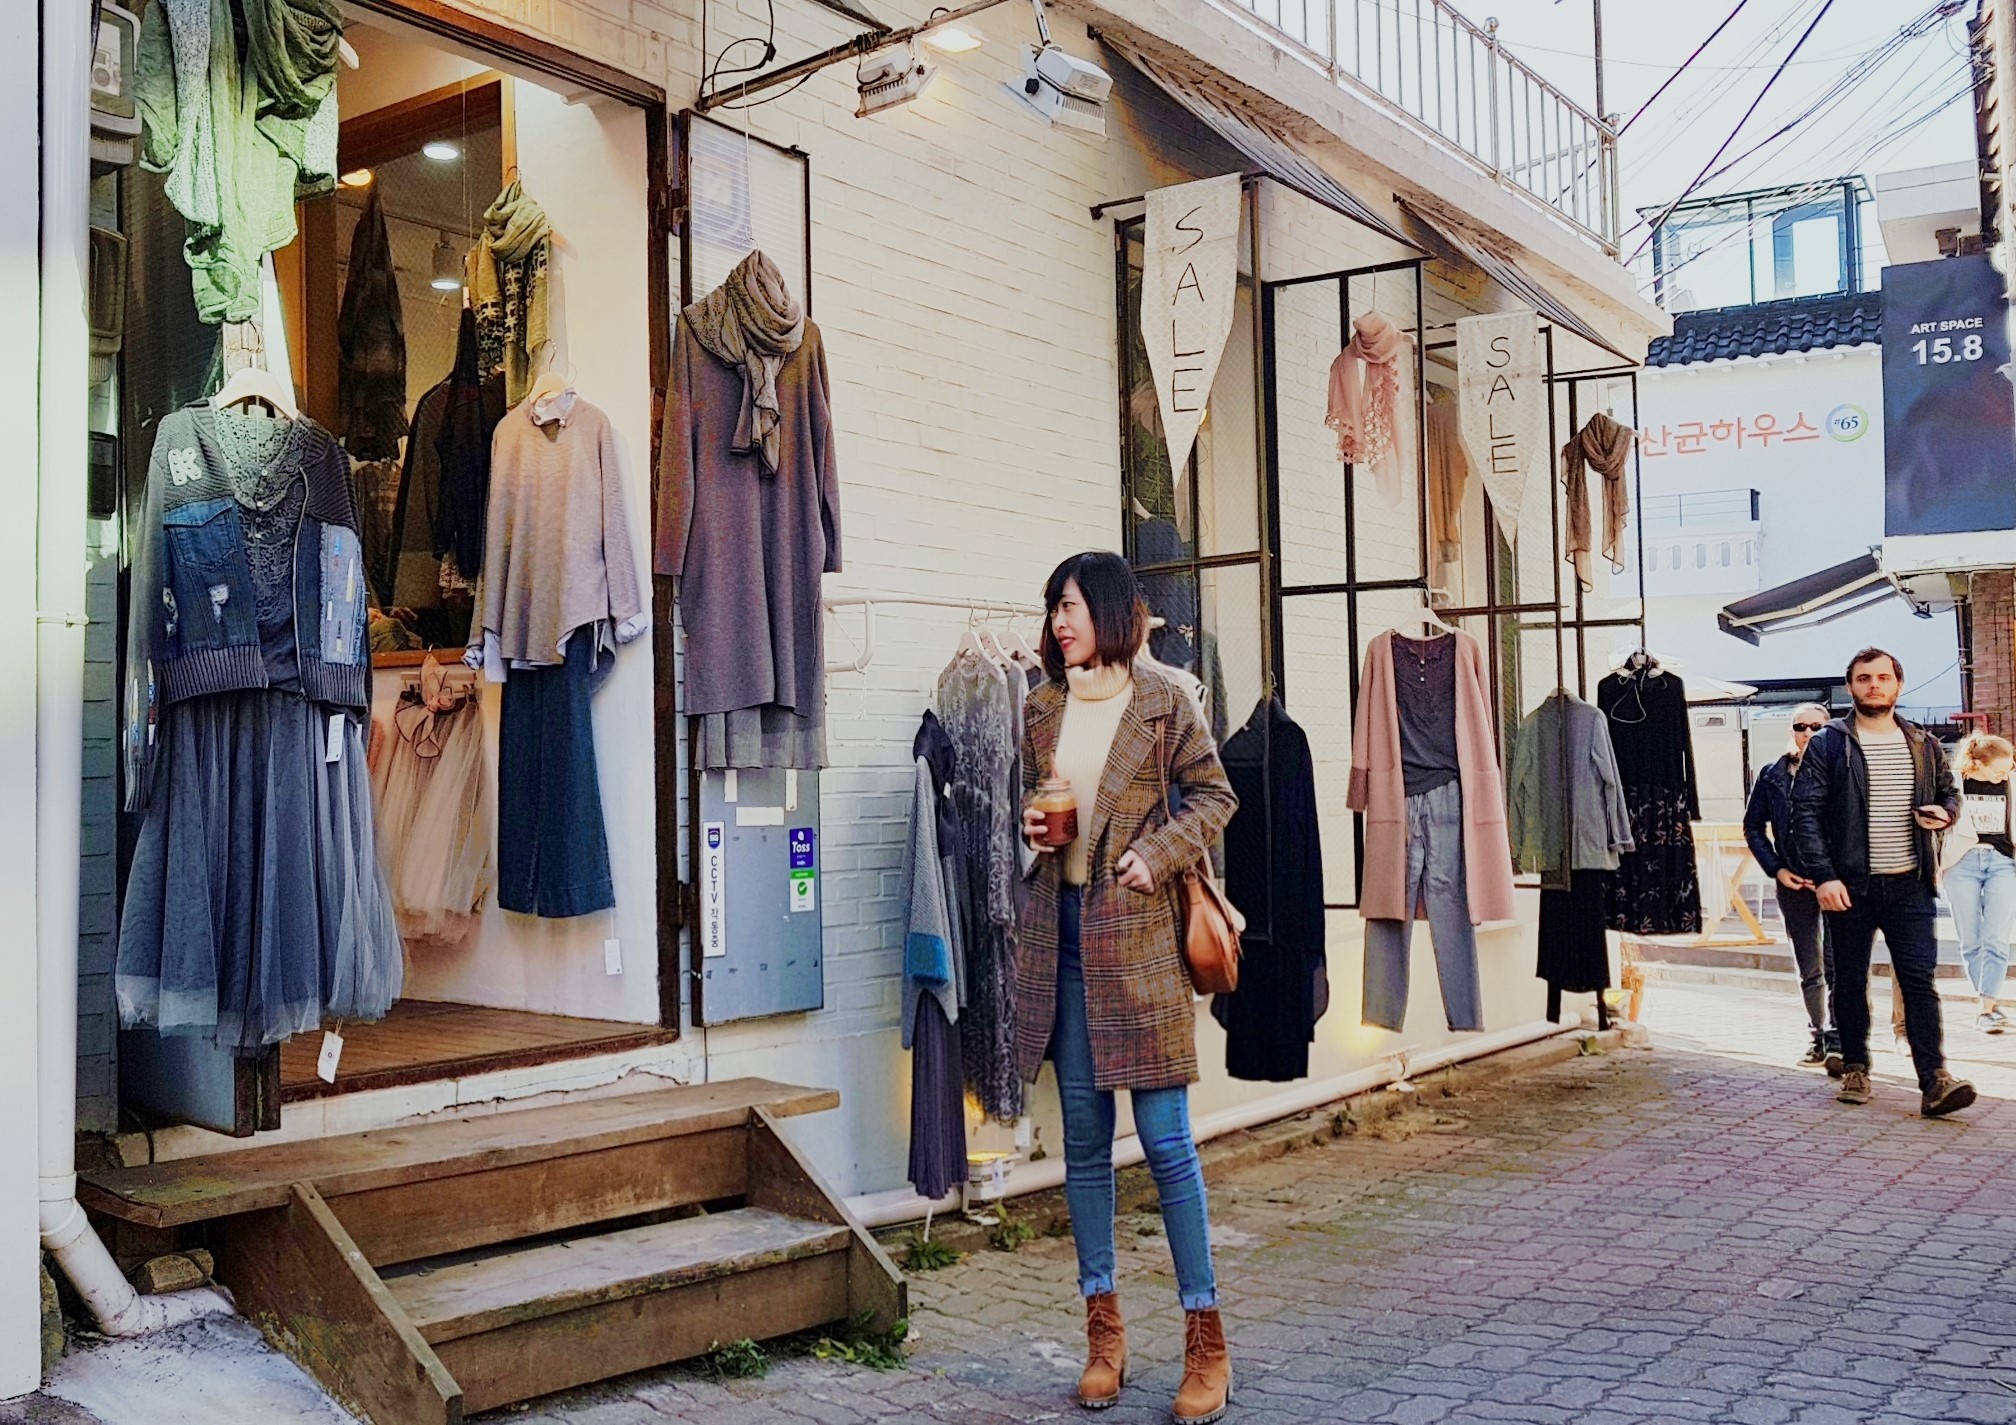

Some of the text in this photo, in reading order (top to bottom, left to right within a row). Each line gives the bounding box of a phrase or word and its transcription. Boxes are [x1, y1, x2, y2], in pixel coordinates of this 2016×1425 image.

[1172, 206, 1205, 412] SALE
[1910, 317, 1984, 335] ART SPACE
[1911, 334, 1984, 366] 15.8
[1486, 336, 1518, 474] SALE
[1631, 411, 1820, 457] 산균하우스
[168, 446, 203, 486] K
[792, 841, 811, 853] Toss
